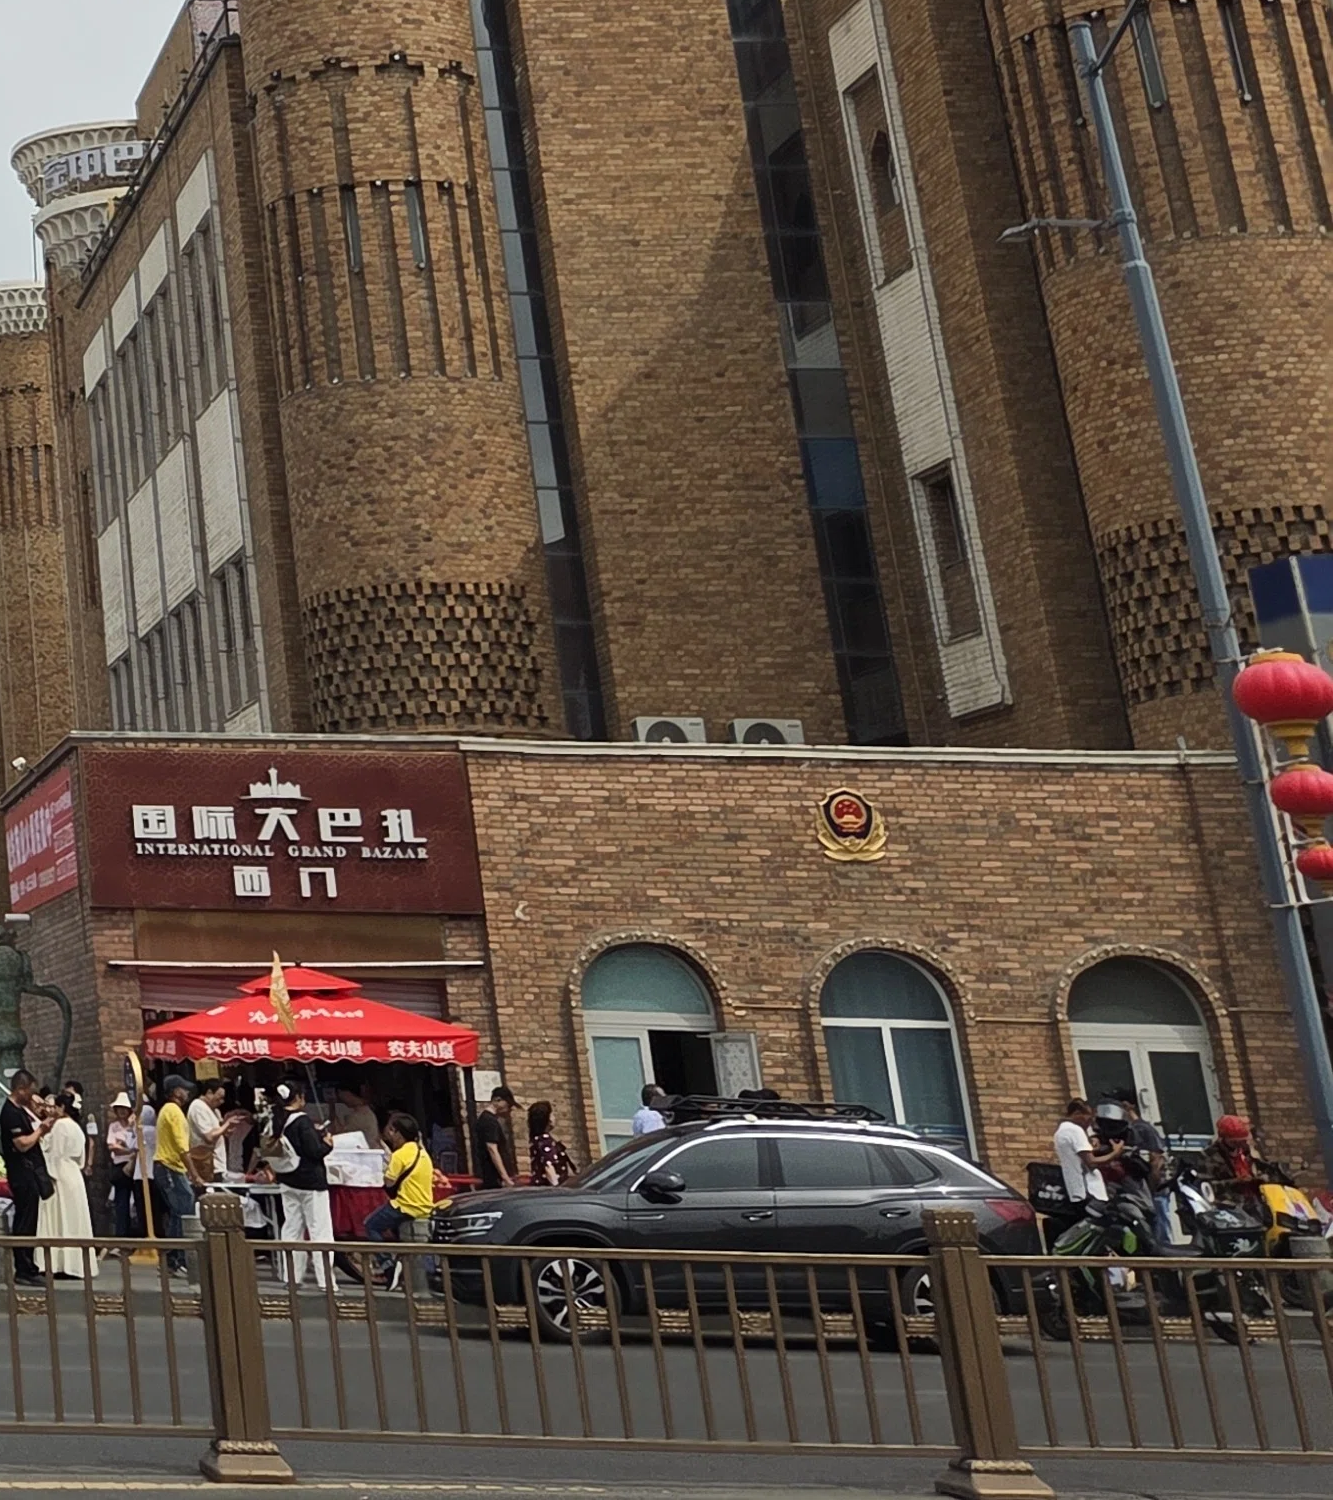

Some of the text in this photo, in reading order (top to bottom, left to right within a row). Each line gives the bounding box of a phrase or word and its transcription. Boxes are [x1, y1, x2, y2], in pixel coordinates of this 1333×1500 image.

[132, 805, 428, 843] 国际大巴扎
[136, 842, 429, 859] INTERNATIONAL GRAND BAZAAR
[233, 866, 338, 898] 西门
[204, 1037, 271, 1055] 农夫山泉
[295, 1039, 363, 1057] 农夫山泉
[387, 1040, 456, 1059] 农夫山泉
